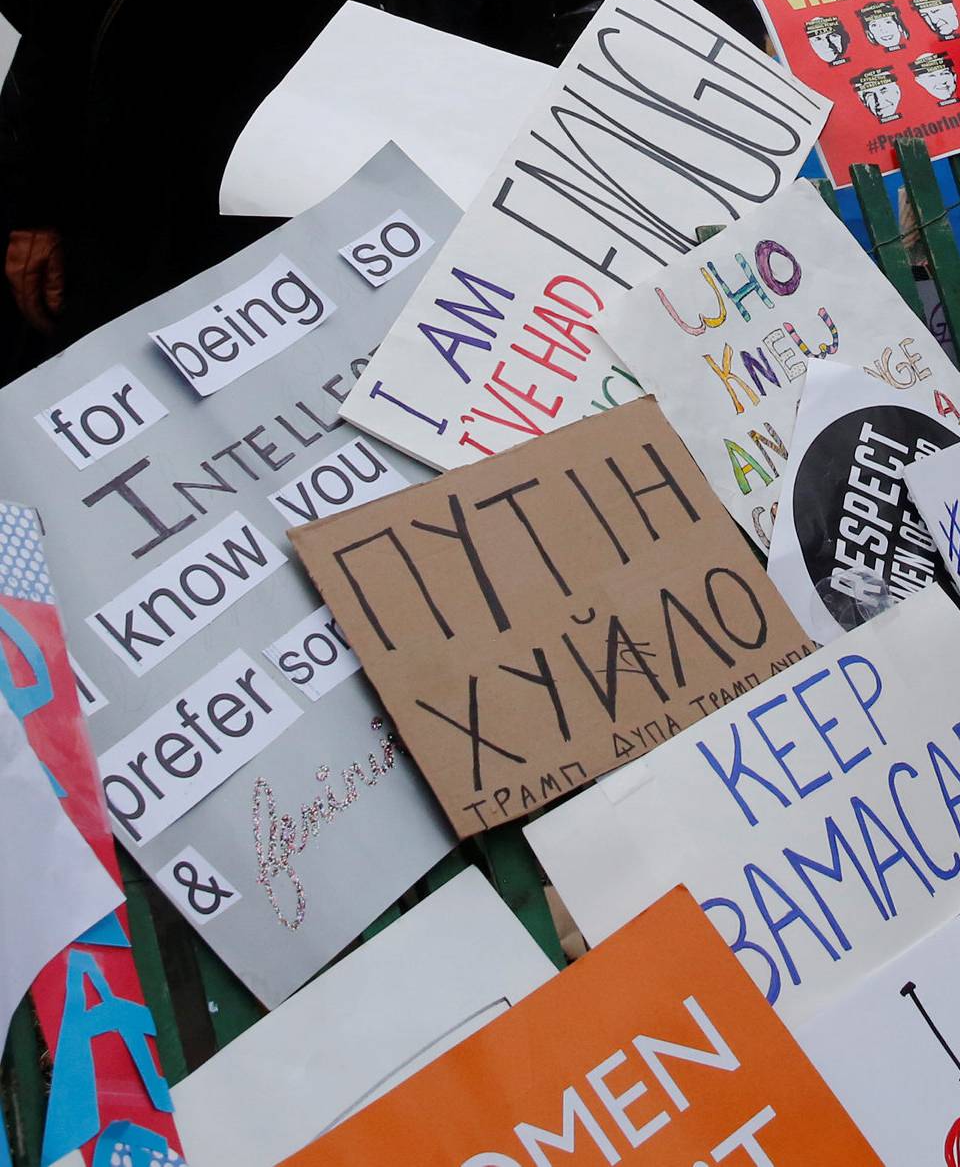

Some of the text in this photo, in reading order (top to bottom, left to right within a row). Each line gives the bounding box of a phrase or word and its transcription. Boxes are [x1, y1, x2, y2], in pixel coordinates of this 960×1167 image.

[52, 220, 422, 460] for being so
[369, 380, 449, 436] I
[416, 266, 517, 385] AM
[510, 274, 606, 382] HAD
[654, 239, 802, 336] WHO
[702, 307, 839, 415] KNEW
[94, 525, 269, 662] know
[333, 442, 701, 651] ПУТІН
[829, 421, 909, 602] RESPECT
[102, 666, 273, 843] prefer
[462, 762, 588, 832] ТРАМП
[689, 672, 761, 717] ТРАМП
[696, 654, 888, 827] KEEP
[172, 859, 234, 916] &
[460, 994, 742, 1167] MEN
